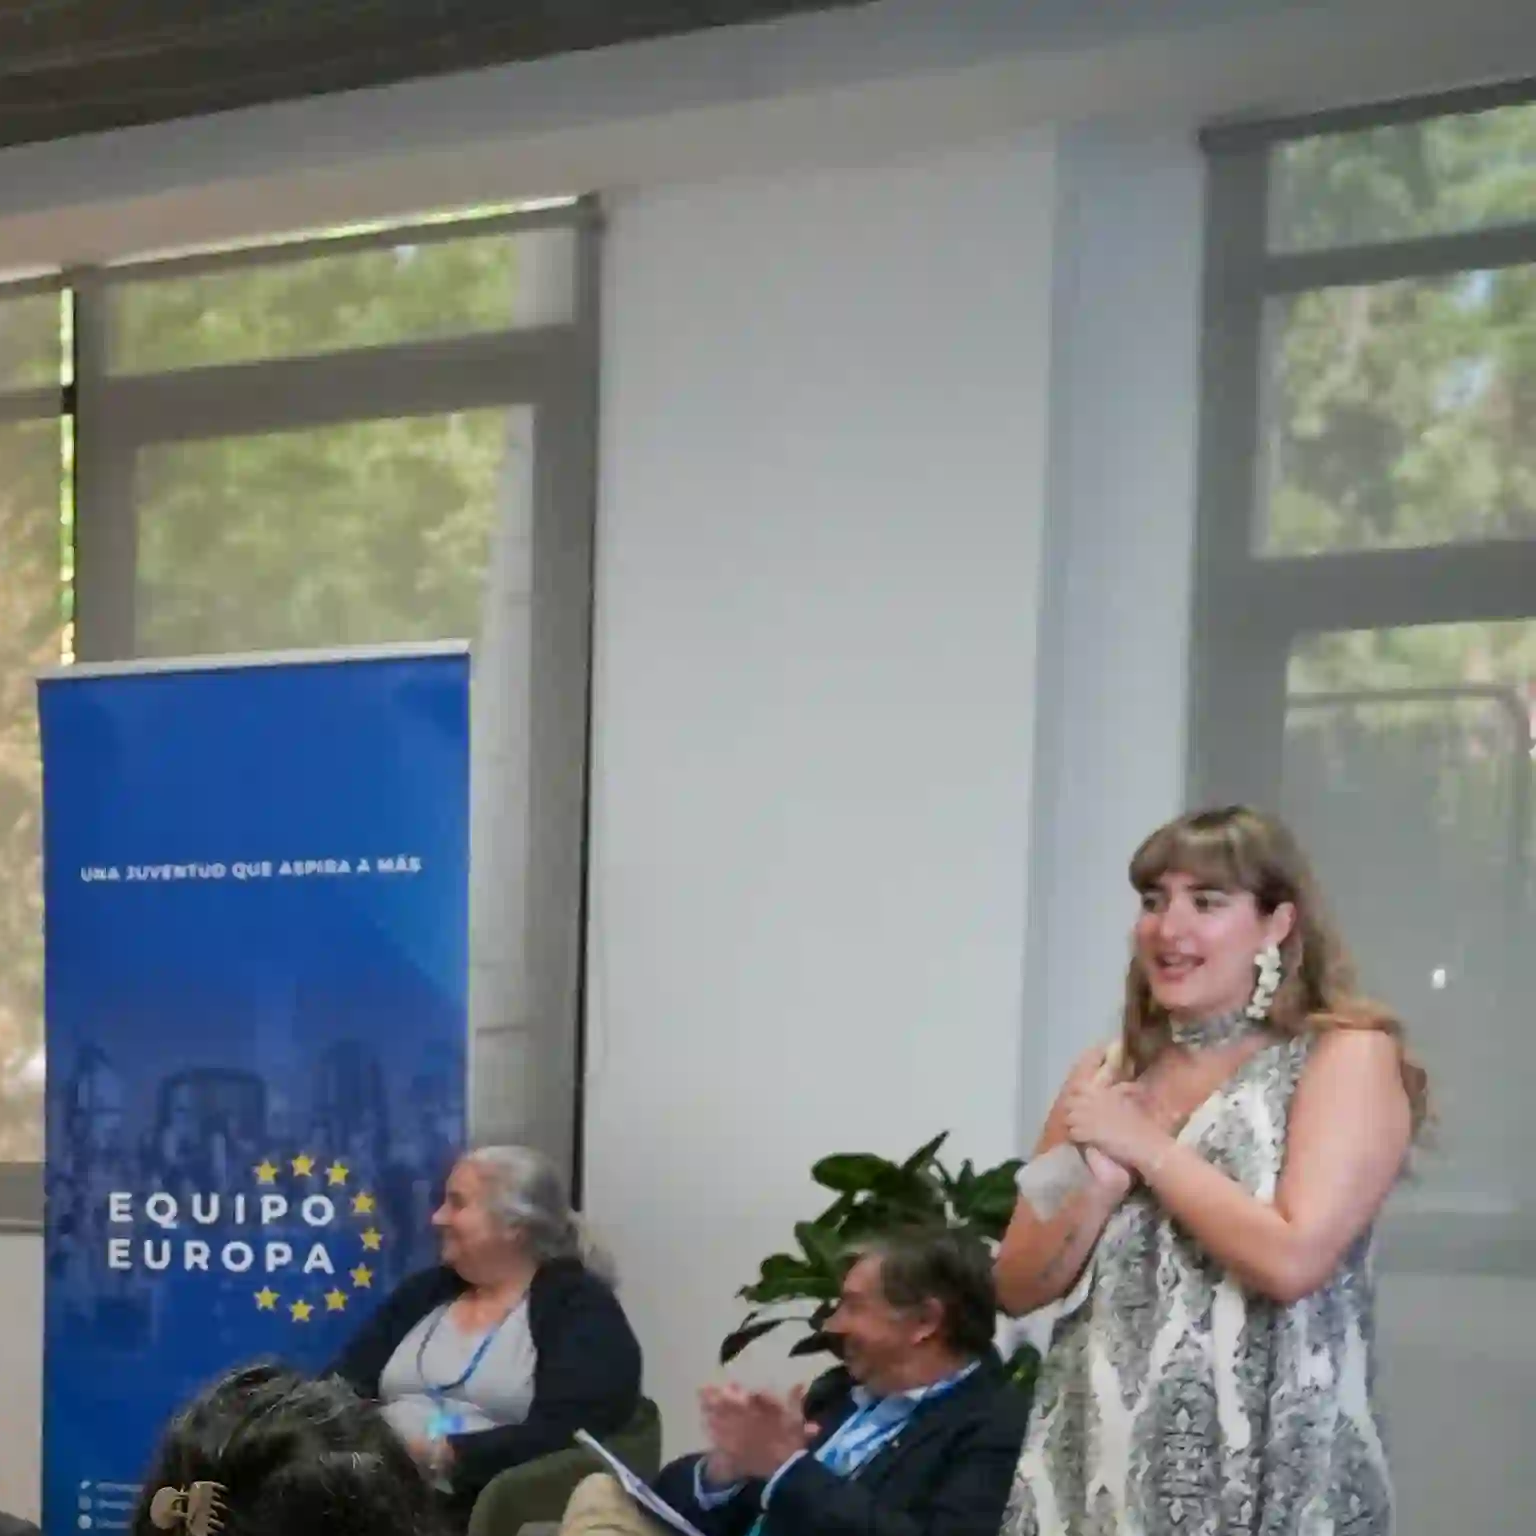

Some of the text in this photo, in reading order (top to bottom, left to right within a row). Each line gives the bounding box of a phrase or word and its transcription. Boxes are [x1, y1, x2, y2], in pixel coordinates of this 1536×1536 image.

[232, 861, 272, 879] QUE
[357, 857, 370, 873] A
[108, 1192, 335, 1229] EQUIPO
[108, 1238, 335, 1275] EUROPA
